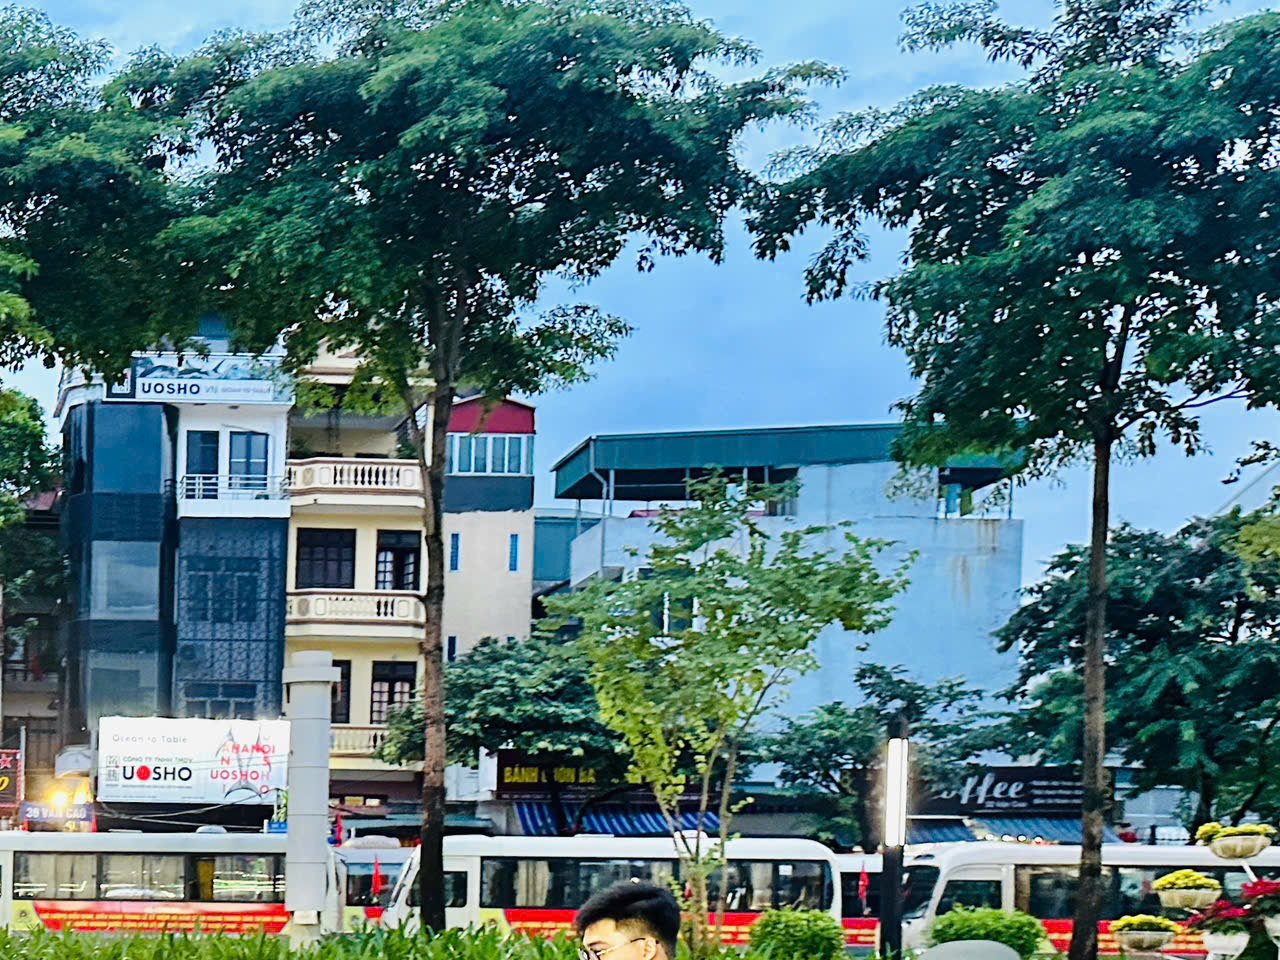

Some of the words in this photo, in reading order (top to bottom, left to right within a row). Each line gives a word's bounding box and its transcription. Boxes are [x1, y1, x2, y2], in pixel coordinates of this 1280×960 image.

[141, 382, 201, 395] UOSHO
[161, 735, 189, 743] Table
[209, 769, 260, 781] UOSHO
